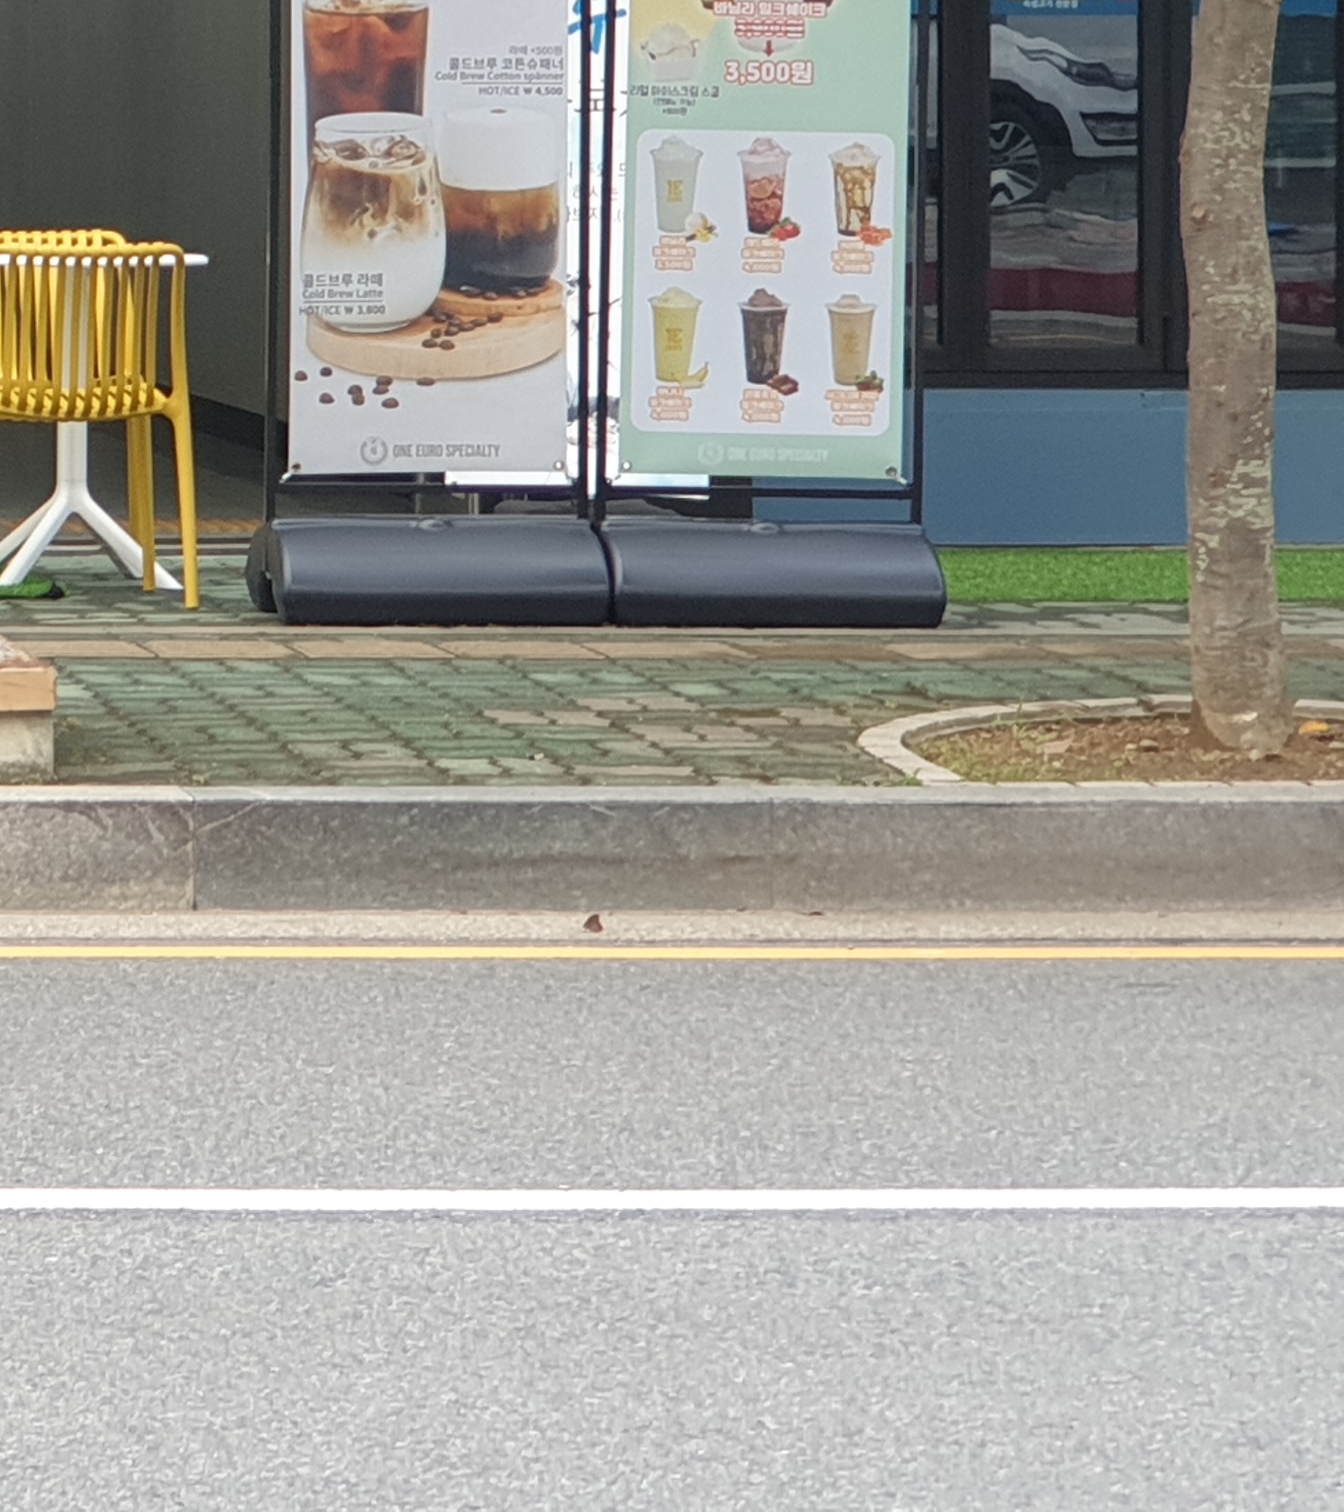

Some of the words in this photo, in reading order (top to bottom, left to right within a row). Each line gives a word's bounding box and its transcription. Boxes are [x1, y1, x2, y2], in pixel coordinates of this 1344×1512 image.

[724, 59, 815, 86] 3,500원
[392, 443, 413, 459] ONE
[416, 443, 443, 459] EURO
[445, 442, 501, 458] SPECIALTY
